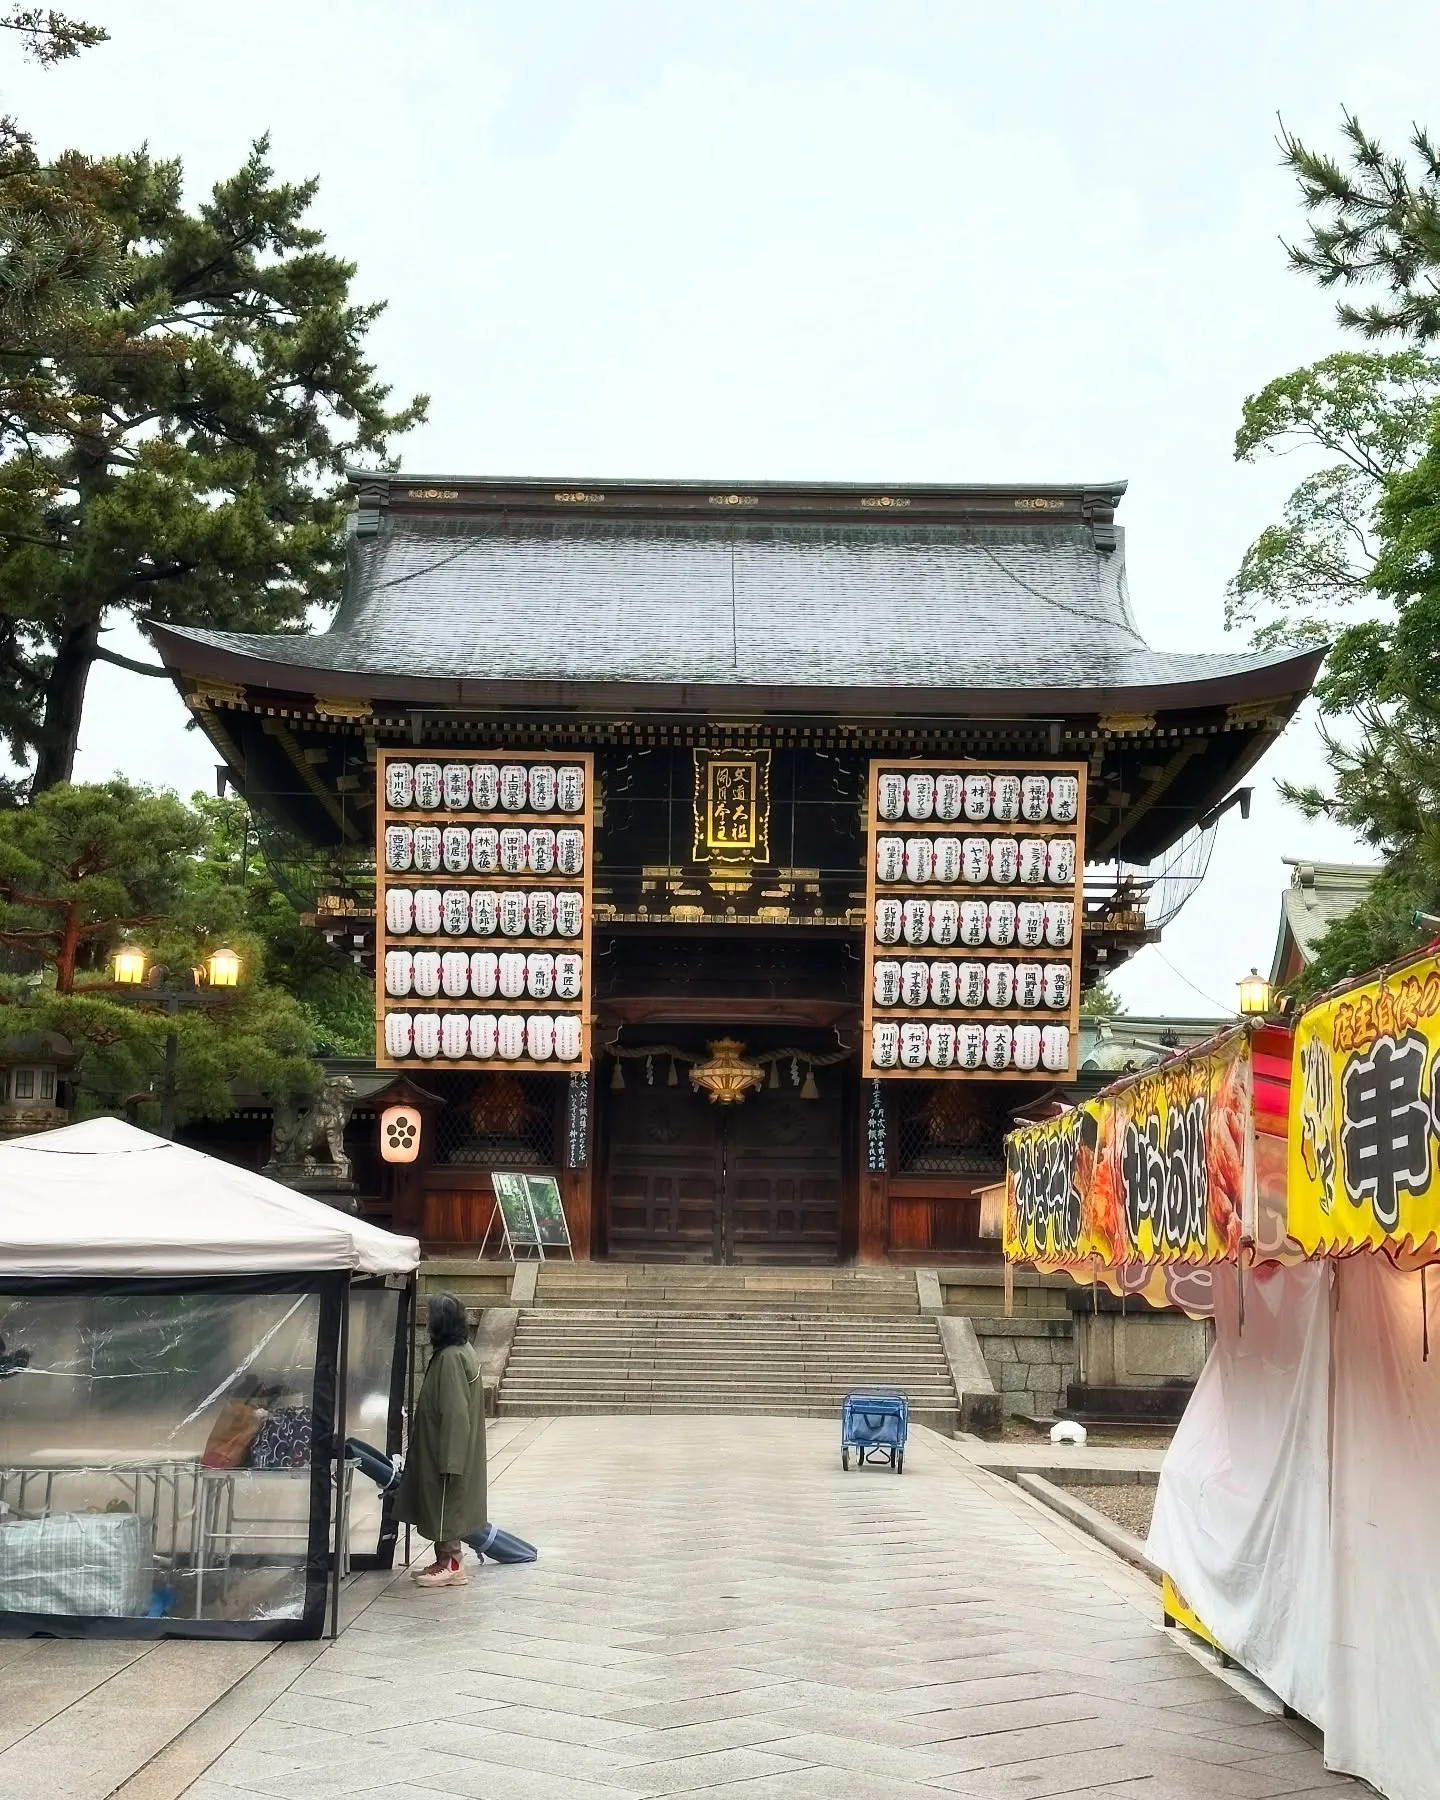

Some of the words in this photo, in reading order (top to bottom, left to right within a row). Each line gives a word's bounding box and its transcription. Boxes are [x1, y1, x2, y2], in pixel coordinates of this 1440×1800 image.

[1057, 800, 1072, 819] 老松
[970, 847, 983, 880] ヤギコー
[1056, 863, 1068, 881] もり
[1341, 1029, 1440, 1234] 串
